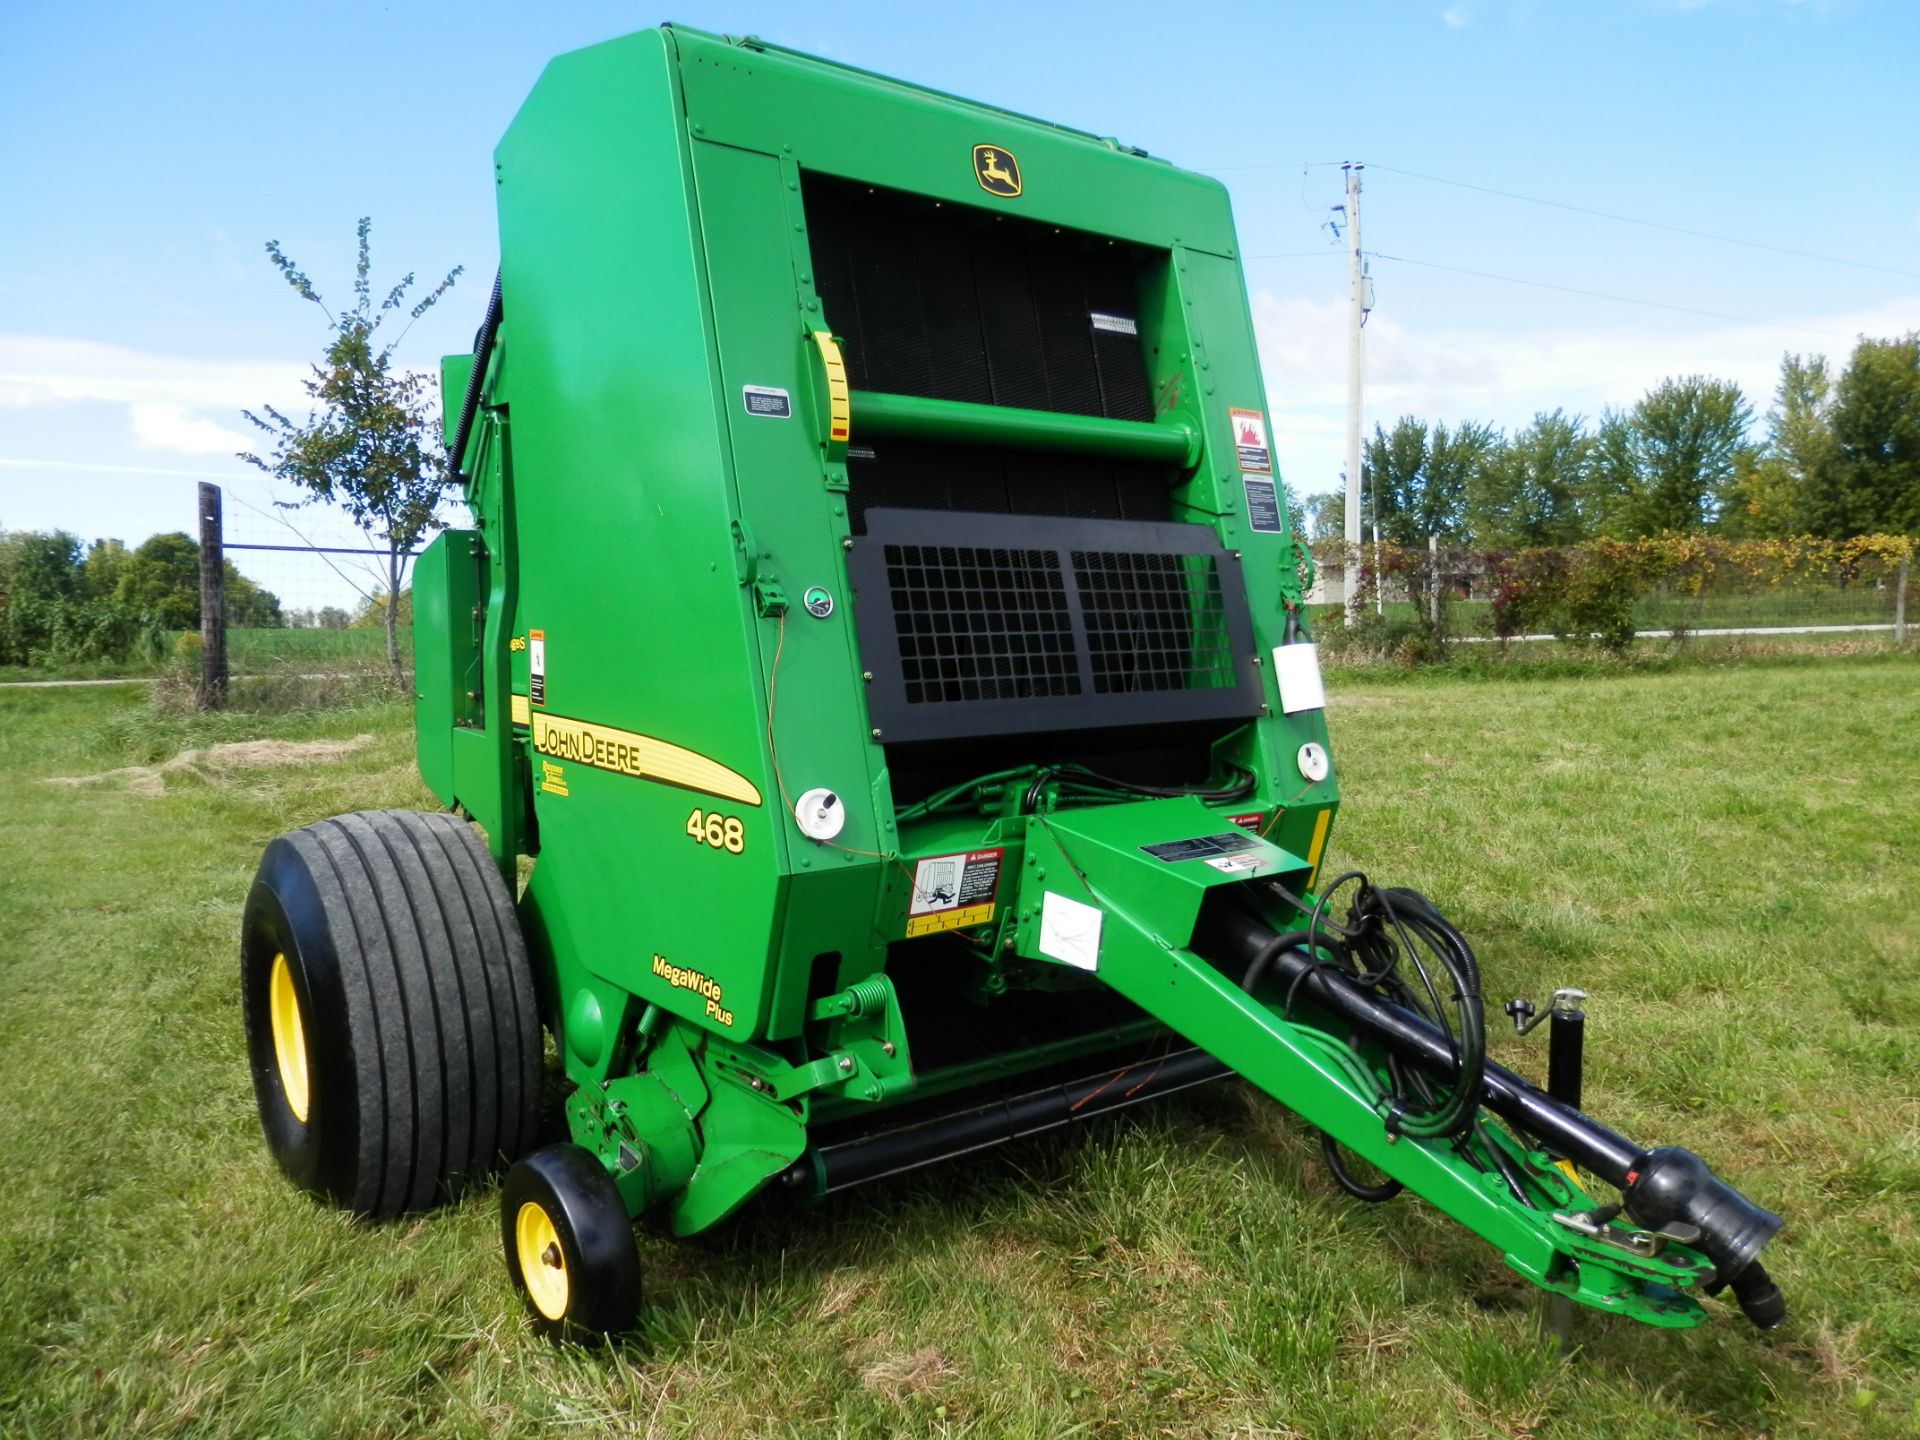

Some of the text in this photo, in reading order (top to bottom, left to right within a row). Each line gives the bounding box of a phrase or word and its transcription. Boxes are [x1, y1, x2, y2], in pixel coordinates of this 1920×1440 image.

[540, 722, 641, 771] JOHN DEERE
[686, 807, 744, 855] 468
[652, 954, 721, 1001] MegaWide
[706, 1000, 733, 1026] Plus
